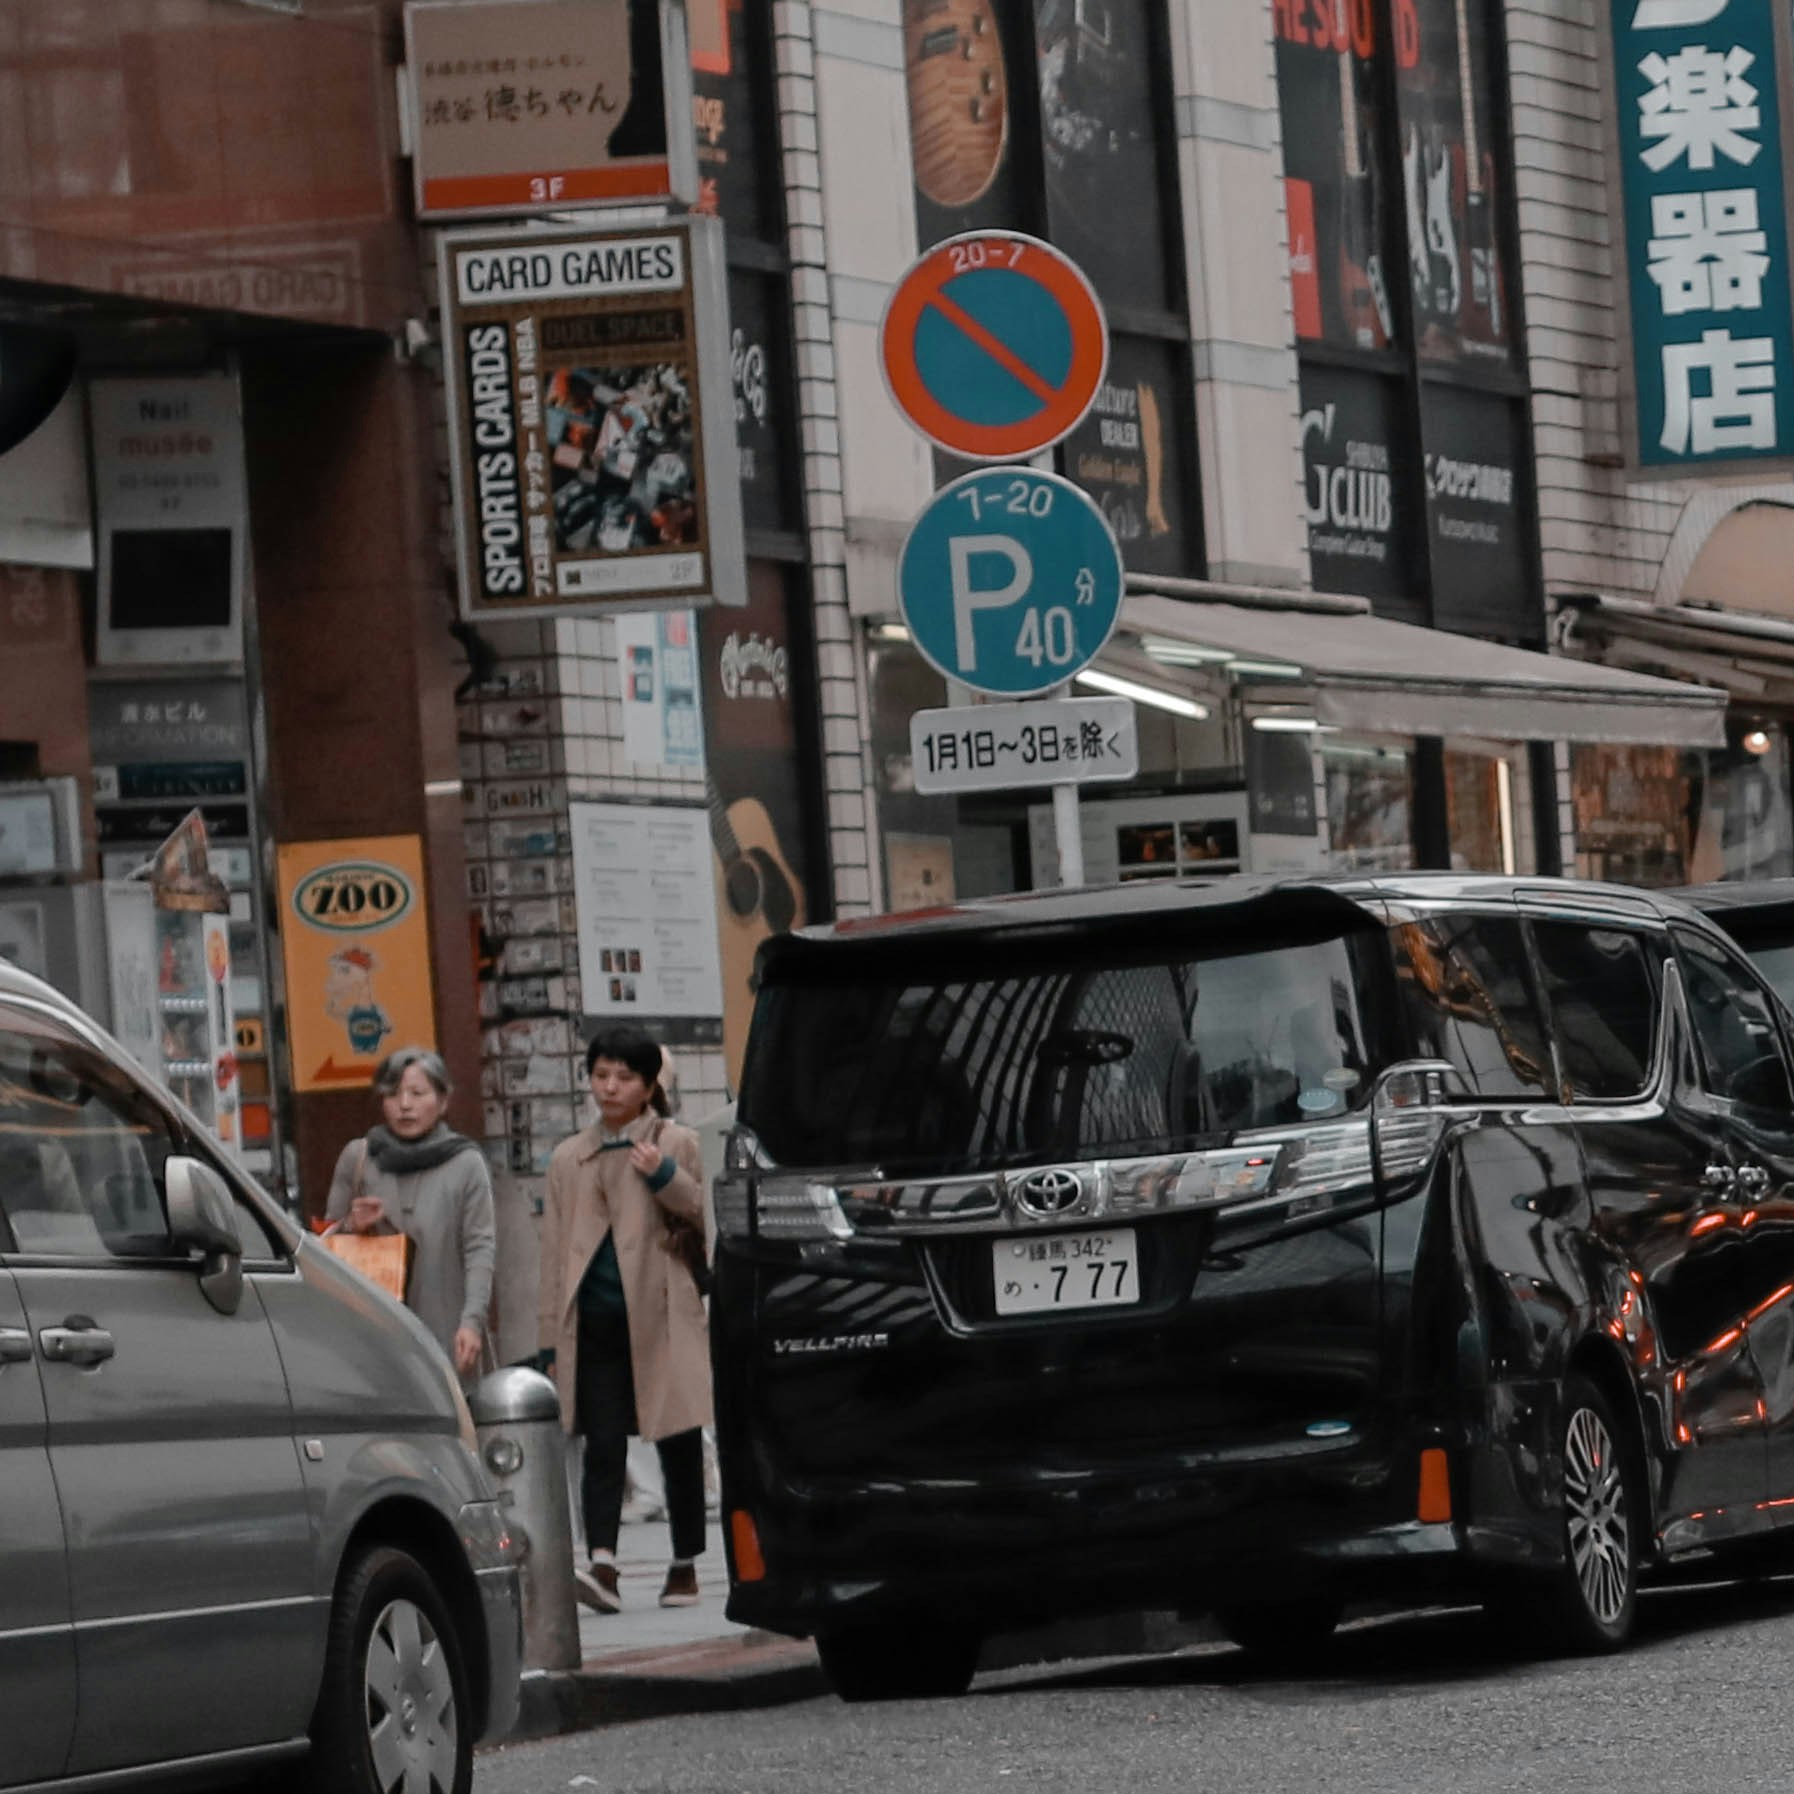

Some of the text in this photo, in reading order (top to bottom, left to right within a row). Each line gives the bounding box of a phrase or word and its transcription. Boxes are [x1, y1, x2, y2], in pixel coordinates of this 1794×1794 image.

[529, 176, 565, 201] 3F
[1631, 0, 1777, 455] 楽器店
[465, 243, 675, 293] CARD GAMES
[949, 240, 1027, 274] 20-7
[515, 315, 538, 370] NBA
[518, 374, 541, 426] MLB
[468, 325, 523, 593] SPORTS CARDS
[957, 480, 1054, 521] 7-20
[948, 534, 1034, 672] P
[1015, 605, 1074, 667] 40
[311, 881, 398, 915] ZOO
[772, 1332, 890, 1354] VELLFIRE
